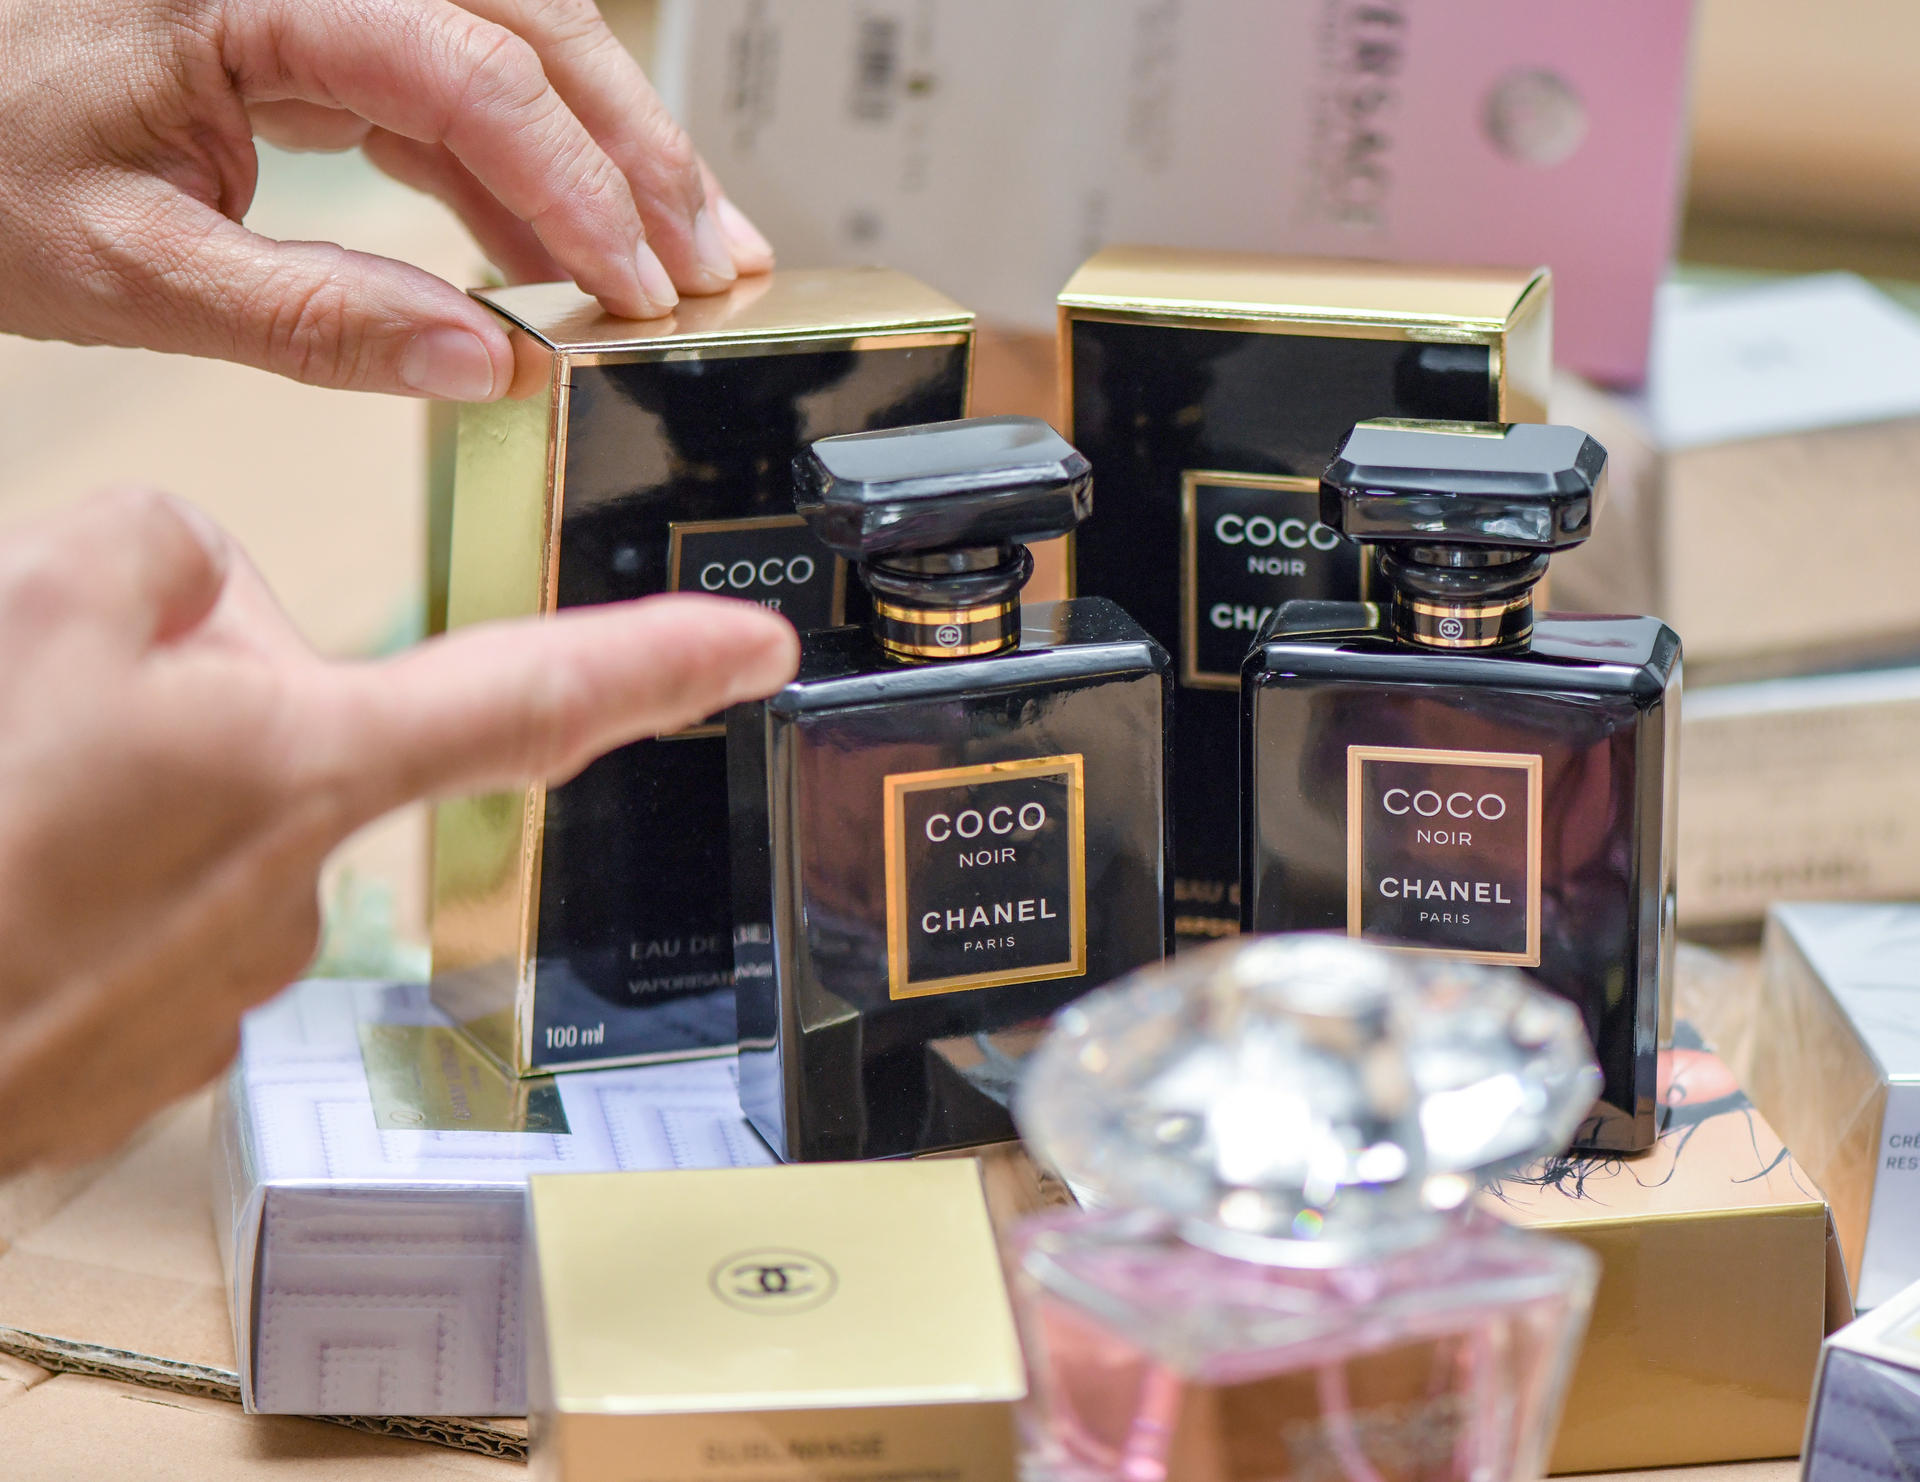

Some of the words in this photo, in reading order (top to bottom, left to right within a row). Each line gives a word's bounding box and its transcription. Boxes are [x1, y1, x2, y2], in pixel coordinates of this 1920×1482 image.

[1214, 513, 1340, 550] COCO
[700, 554, 815, 591] COCO
[1247, 556, 1306, 576] NOIR
[1383, 788, 1506, 820] COCO
[925, 802, 1046, 842] COCO
[1417, 830, 1472, 845] NOIR
[959, 848, 1017, 868] NOIR
[1379, 877, 1511, 904] CHANEL
[921, 898, 1056, 933] CHANEL
[1420, 912, 1471, 924] PARIS
[630, 938, 682, 960] EAU
[963, 936, 1016, 952] PARIS
[546, 1025, 578, 1049] 100
[581, 1022, 605, 1046] ml
